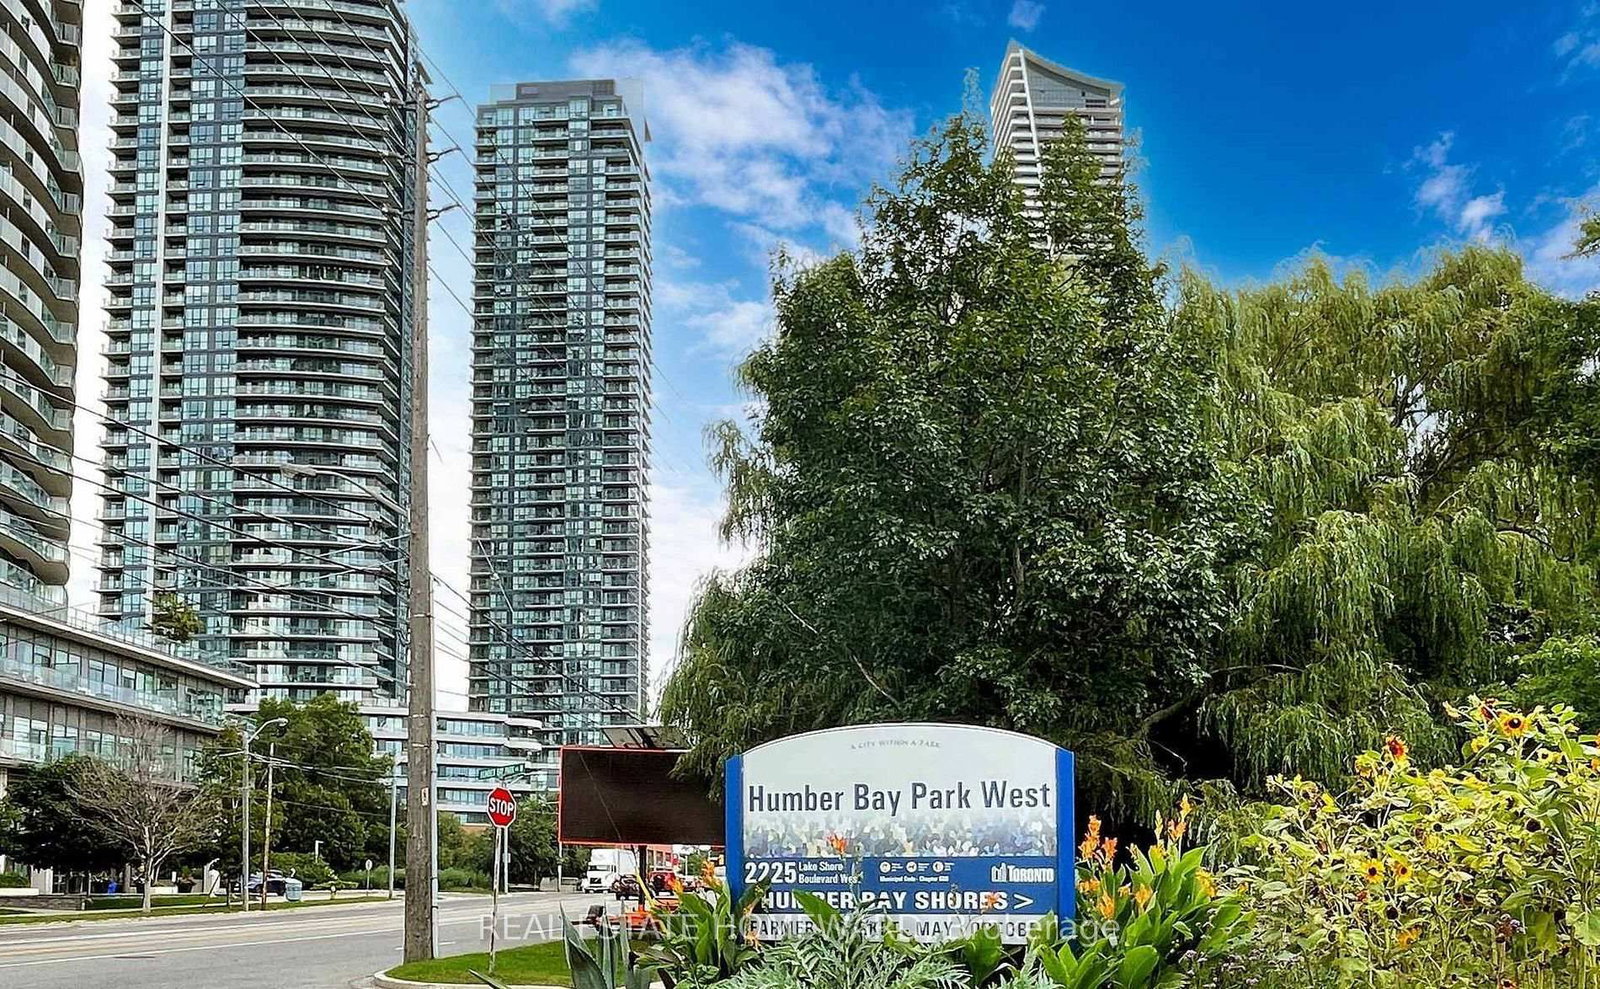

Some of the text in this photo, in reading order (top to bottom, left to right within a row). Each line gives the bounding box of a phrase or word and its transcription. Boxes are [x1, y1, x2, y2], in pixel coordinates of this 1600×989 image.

[489, 797, 514, 817] STOP
[748, 780, 1051, 817] Humber Bay Park West
[744, 861, 797, 884] 2225
[798, 861, 844, 871] Lake Shore
[1007, 865, 1055, 883] TORONTO
[798, 873, 862, 884] Boulevard Wes
[914, 891, 1008, 910] SHORES
[916, 921, 953, 936] MAY
